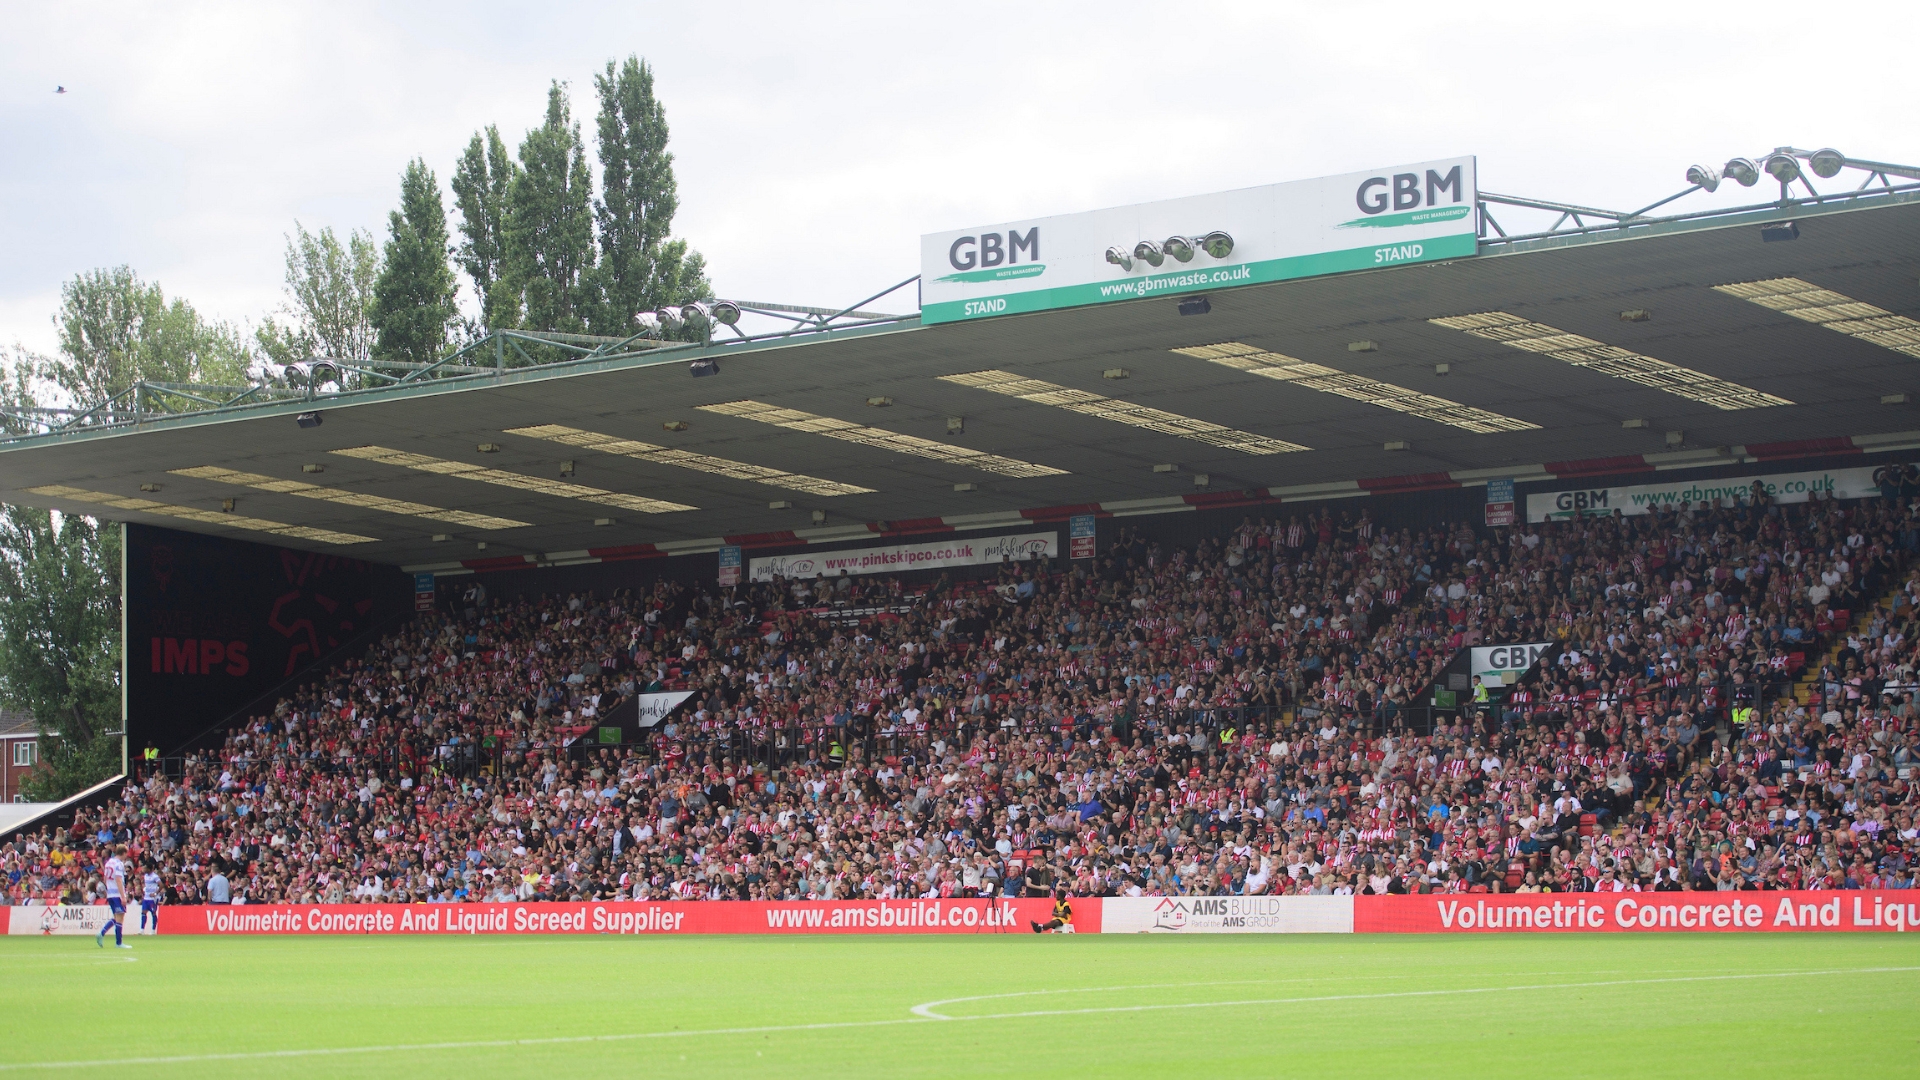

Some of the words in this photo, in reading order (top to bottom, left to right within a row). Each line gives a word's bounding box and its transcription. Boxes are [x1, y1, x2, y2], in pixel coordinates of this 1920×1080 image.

[1356, 165, 1462, 215] GBM
[1411, 212, 1430, 221] WASTE
[1430, 208, 1468, 218] MANAGEMENT
[949, 226, 1039, 271] GBM
[1374, 244, 1423, 263] STAND
[1012, 267, 1043, 275] MANAGEMENT
[1100, 265, 1251, 296] www.gbmwaste.co.uk
[964, 298, 1006, 316] STAND
[1556, 489, 1608, 511] GBM
[1631, 474, 1835, 505] www.gbmwae.co.uk
[825, 545, 973, 569] www.pinkskipco.co.uk
[151, 637, 249, 677] IMPS
[63, 908, 84, 921] AMS
[766, 901, 1017, 928] www.amsbuild.co.uk
[1192, 899, 1228, 916] AMS
[1231, 898, 1280, 915] BUILD
[1437, 899, 1605, 929] Volumetric
[1615, 898, 1763, 928] Concrete
[1773, 897, 1840, 927] And
[80, 921, 94, 930] AMS
[206, 909, 302, 931] Volumetric
[307, 908, 394, 931] Concrete
[400, 908, 439, 931] And
[446, 907, 508, 934] Liquid
[514, 906, 586, 931] Screed
[592, 906, 684, 934] Supplier
[1222, 916, 1245, 927] AMS
[1246, 916, 1280, 927] GROUP
